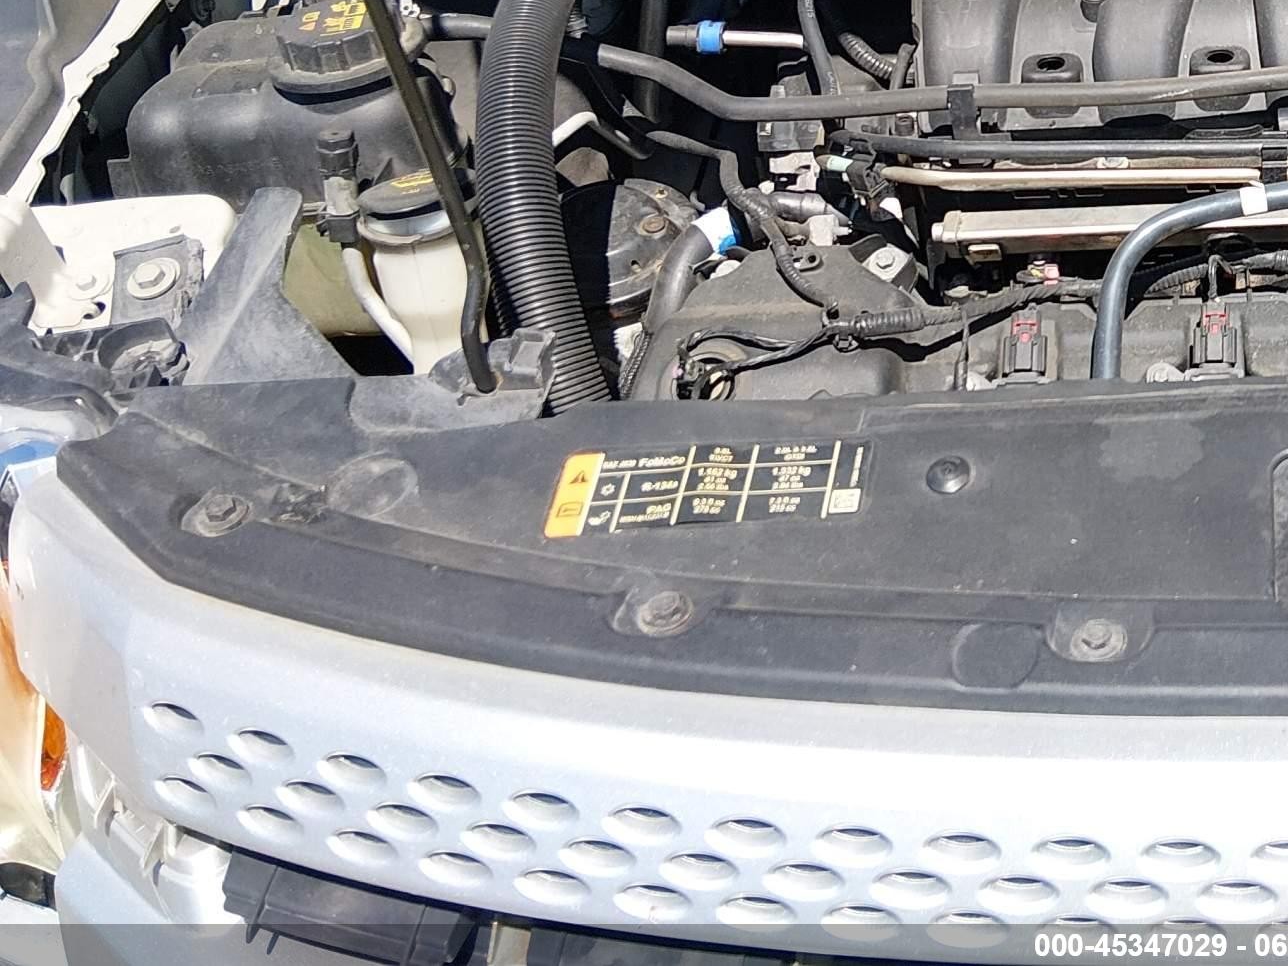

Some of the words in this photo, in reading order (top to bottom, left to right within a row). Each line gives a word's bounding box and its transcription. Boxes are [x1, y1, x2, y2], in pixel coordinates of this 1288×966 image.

[638, 456, 686, 467] FoMoCo
[724, 468, 738, 480] kg
[798, 465, 812, 477] kg
